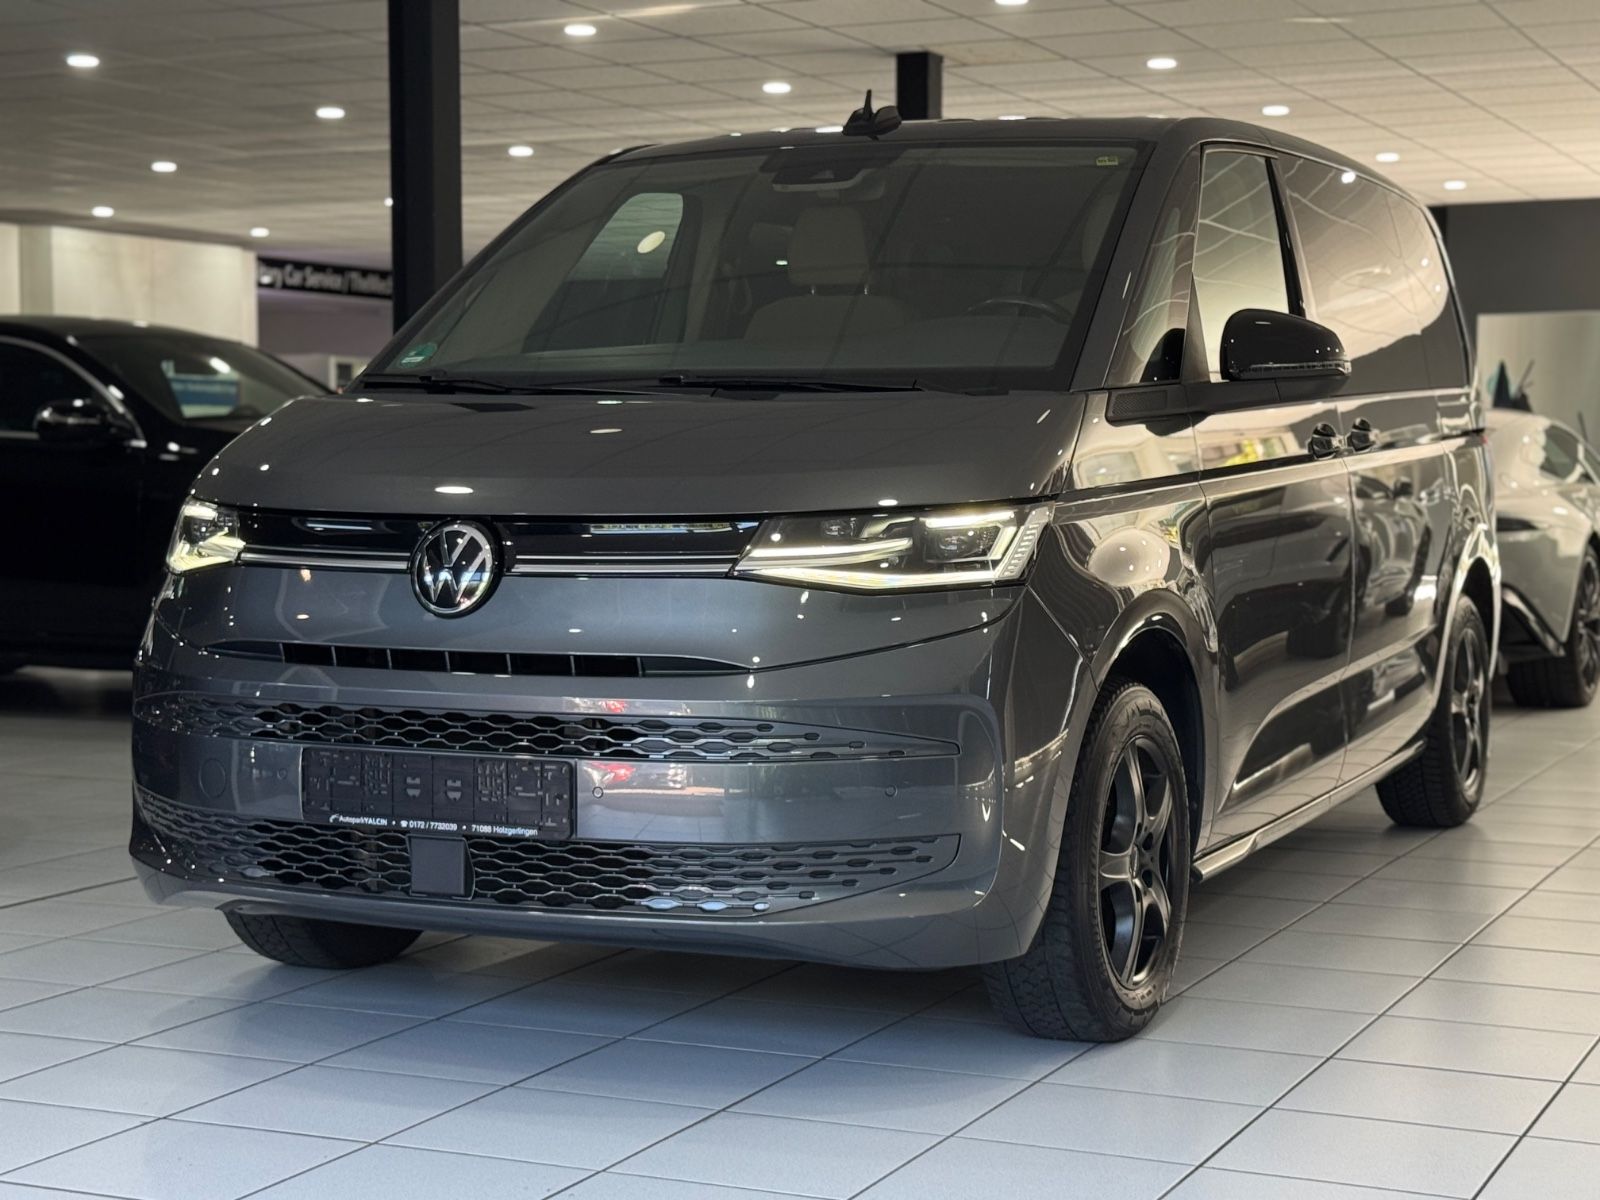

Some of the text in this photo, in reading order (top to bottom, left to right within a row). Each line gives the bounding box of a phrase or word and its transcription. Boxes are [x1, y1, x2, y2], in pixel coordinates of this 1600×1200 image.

[284, 264, 303, 287] Car
[304, 266, 342, 291] Service
[409, 821, 425, 829] 0172
[493, 825, 538, 836] Holzgerlingen
